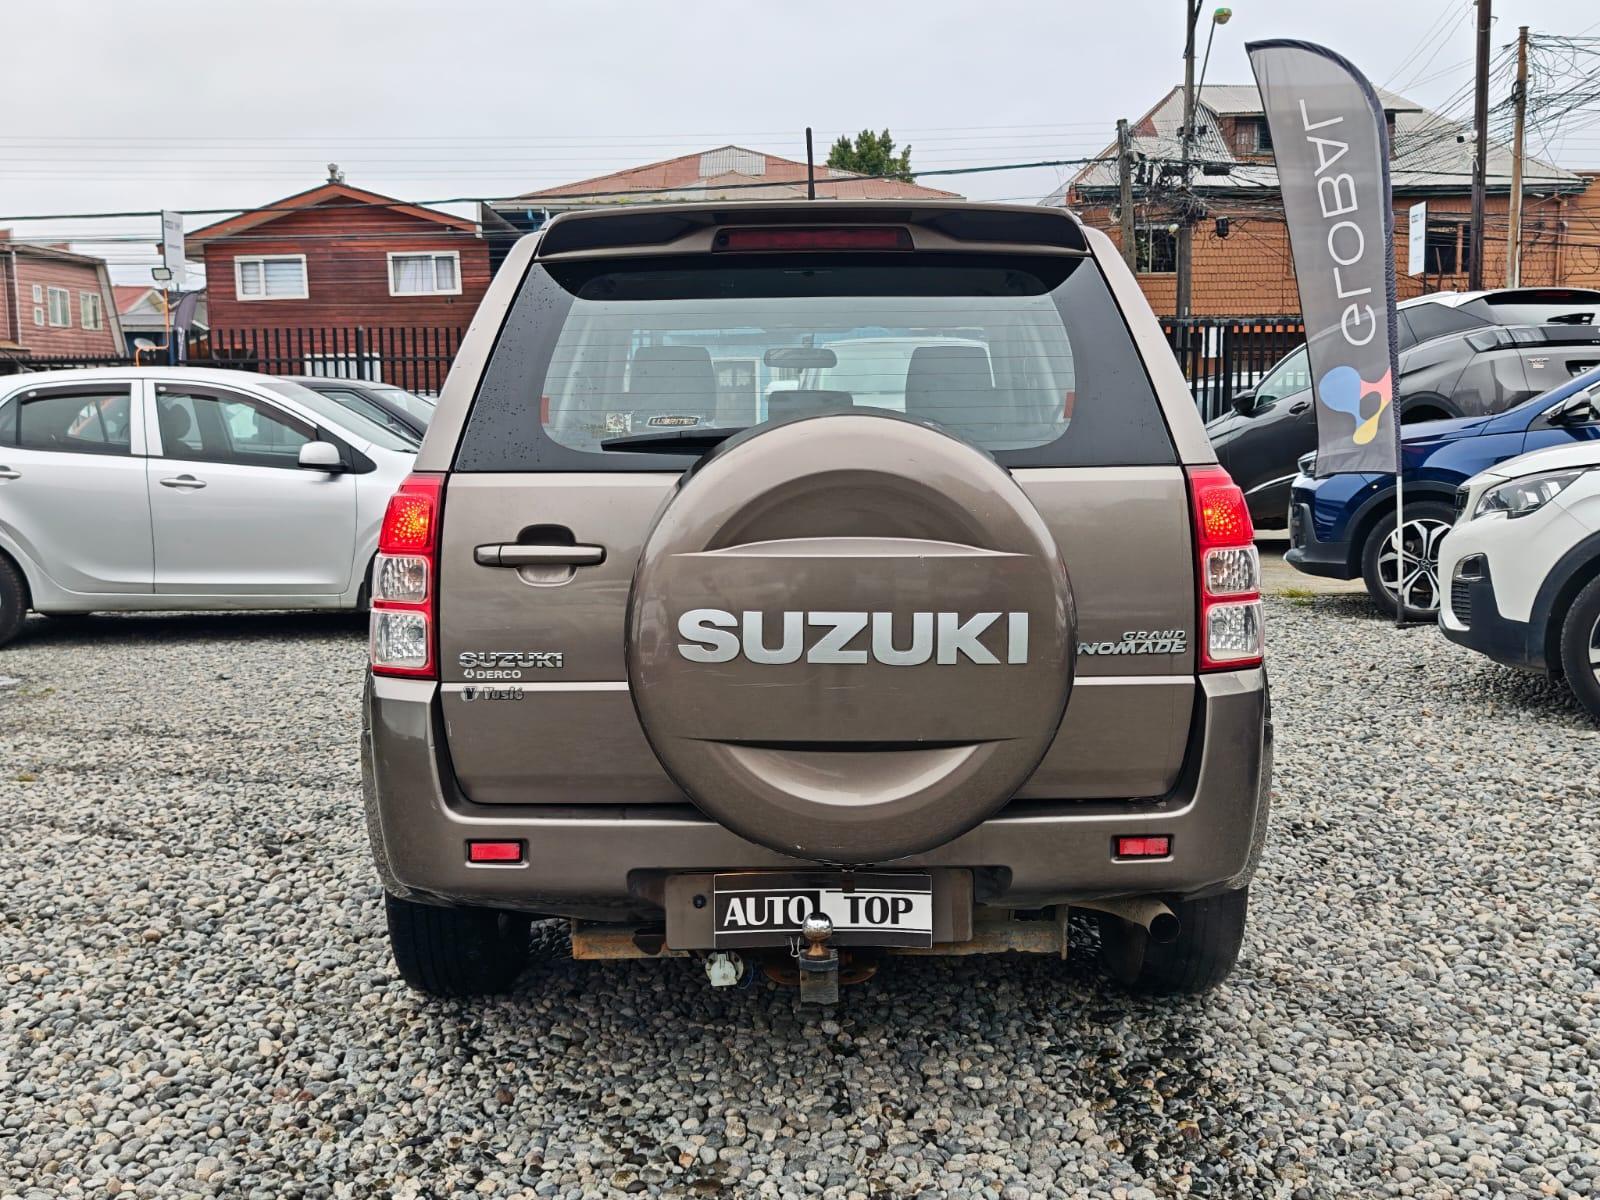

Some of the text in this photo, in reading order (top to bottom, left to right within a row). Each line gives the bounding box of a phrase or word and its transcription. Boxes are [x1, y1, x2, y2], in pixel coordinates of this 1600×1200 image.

[677, 608, 1029, 667] SUZUKI
[1122, 630, 1186, 641] GRAND
[1076, 640, 1187, 655] NOMADE
[458, 652, 564, 669] SUZUKI
[476, 670, 522, 679] DERCO
[723, 894, 914, 928] AUTO TOP
